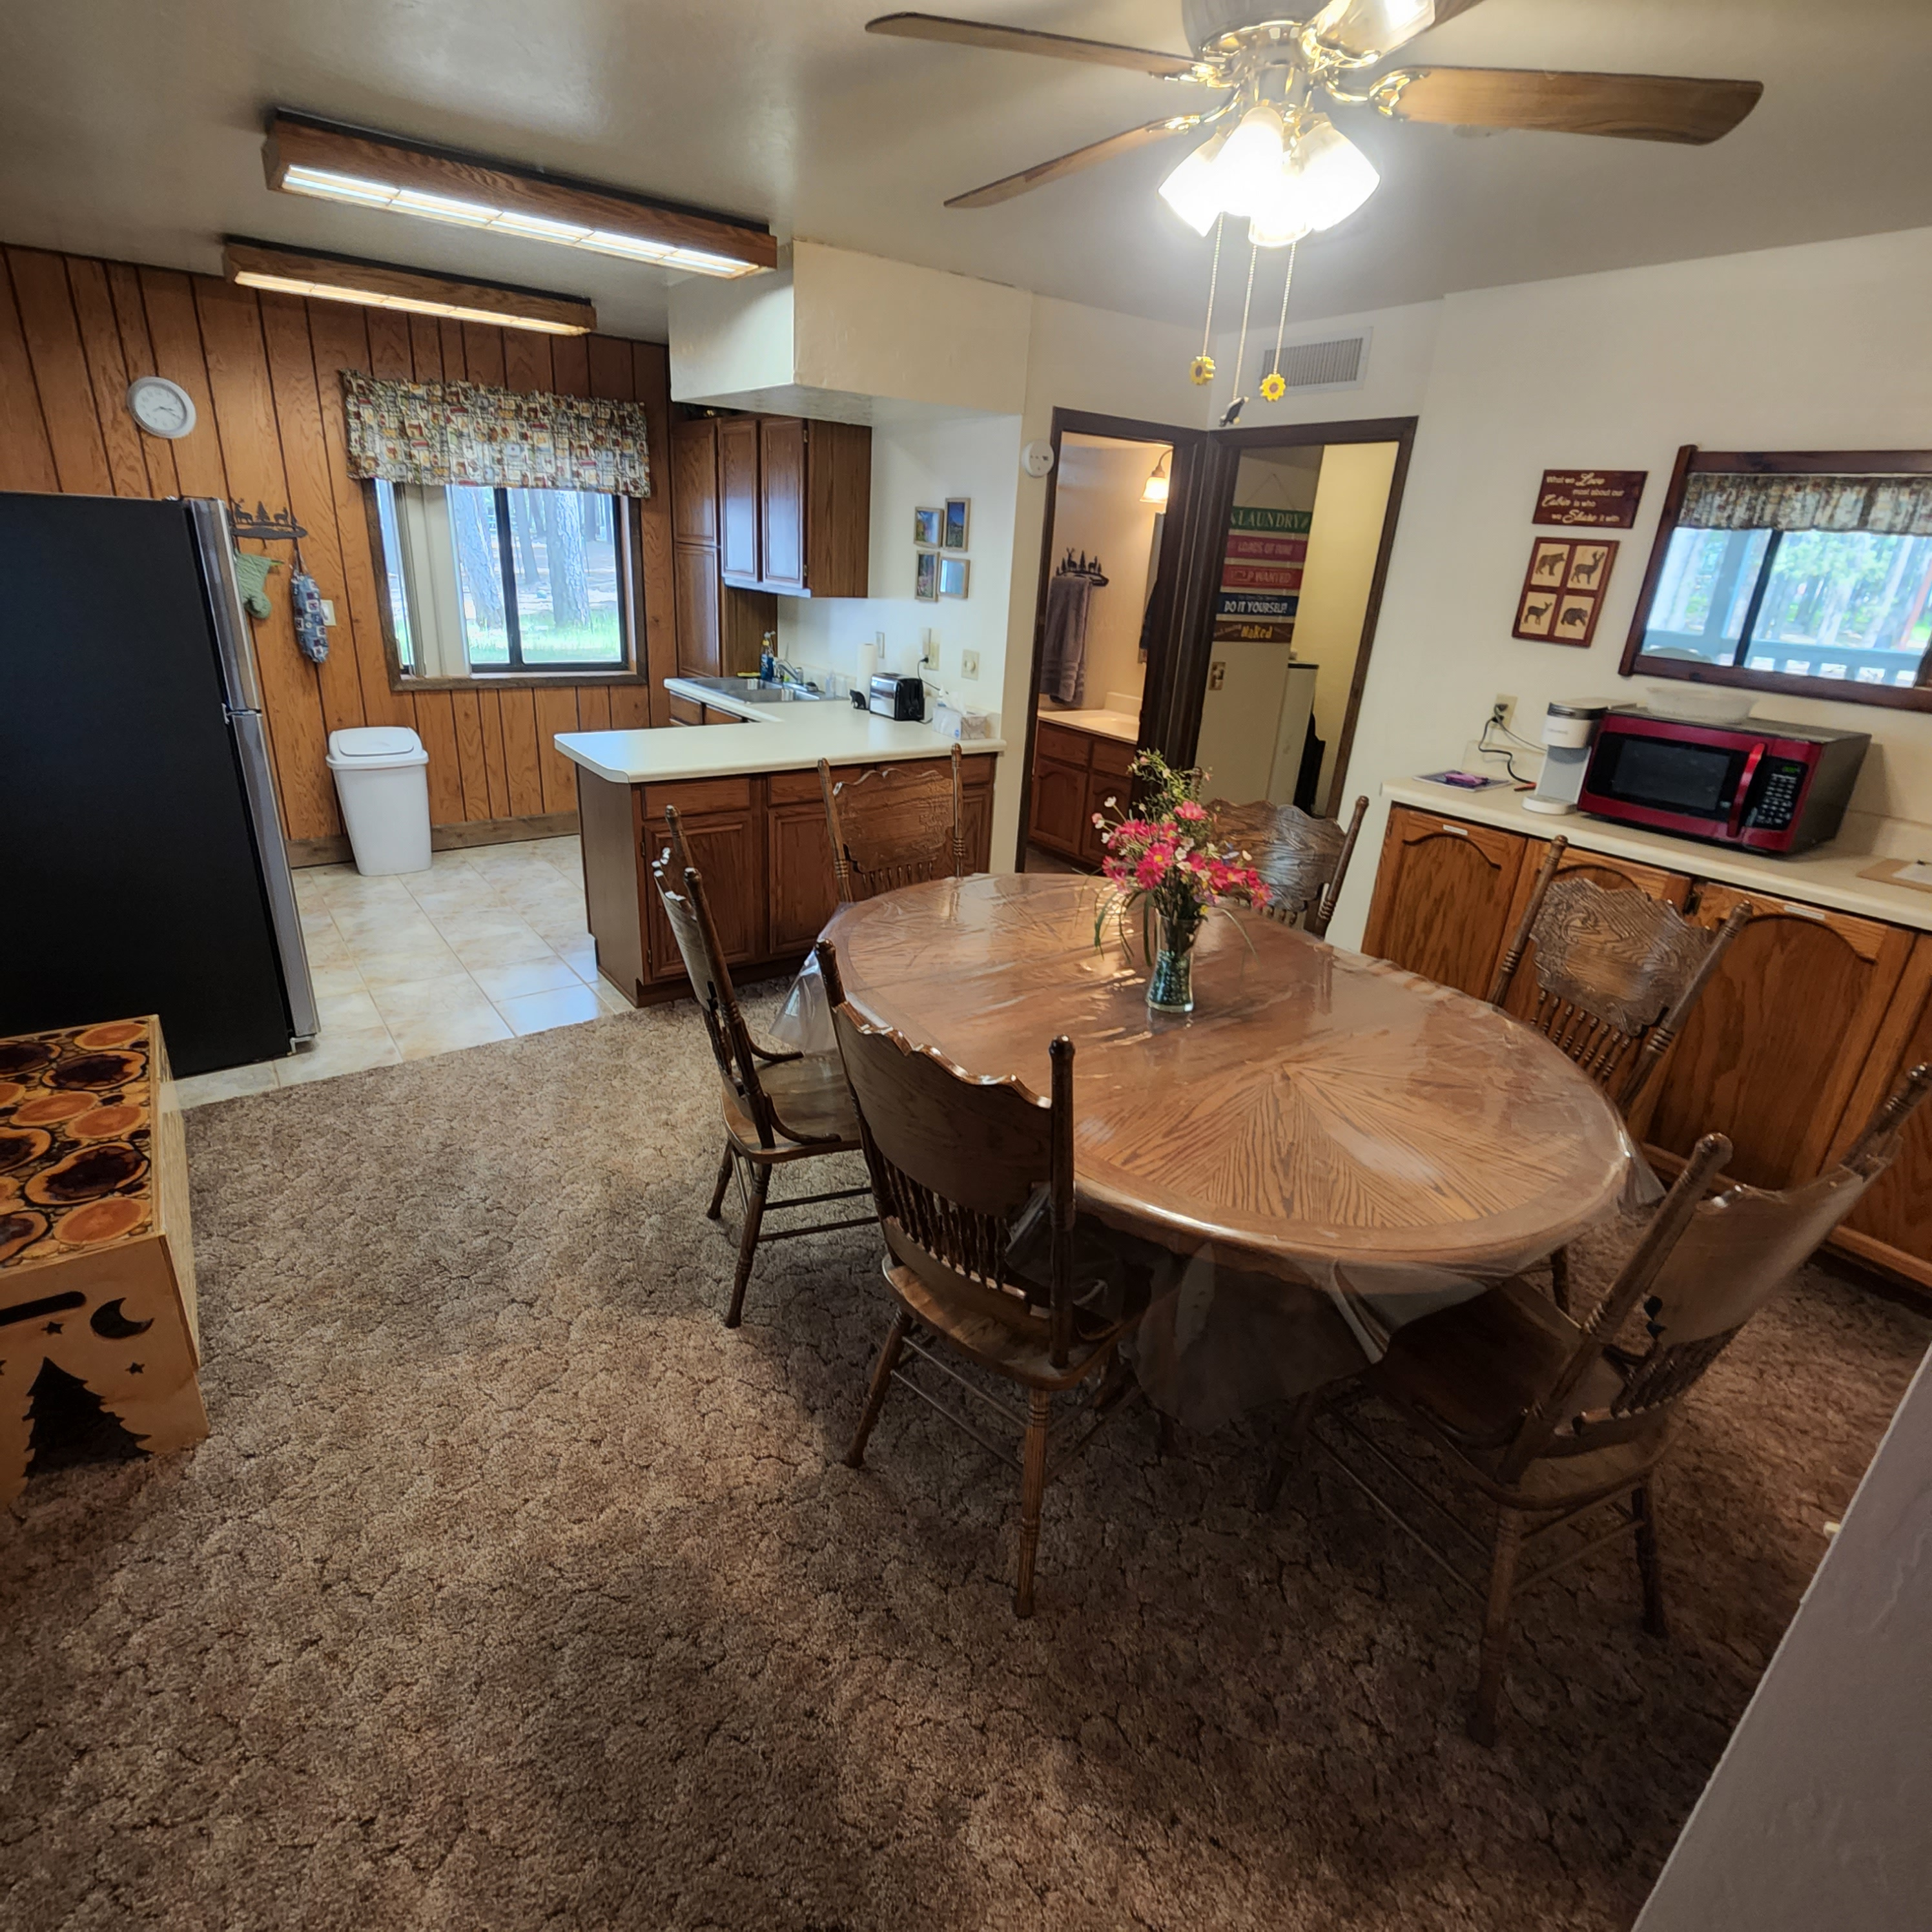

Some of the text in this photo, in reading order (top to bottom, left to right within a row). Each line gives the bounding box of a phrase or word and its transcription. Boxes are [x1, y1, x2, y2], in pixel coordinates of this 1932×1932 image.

[1576, 473, 1605, 486] Love
[1238, 510, 1300, 528] LAUNDRY
[1224, 601, 1236, 611] DO
[1238, 602, 1246, 611] IT
